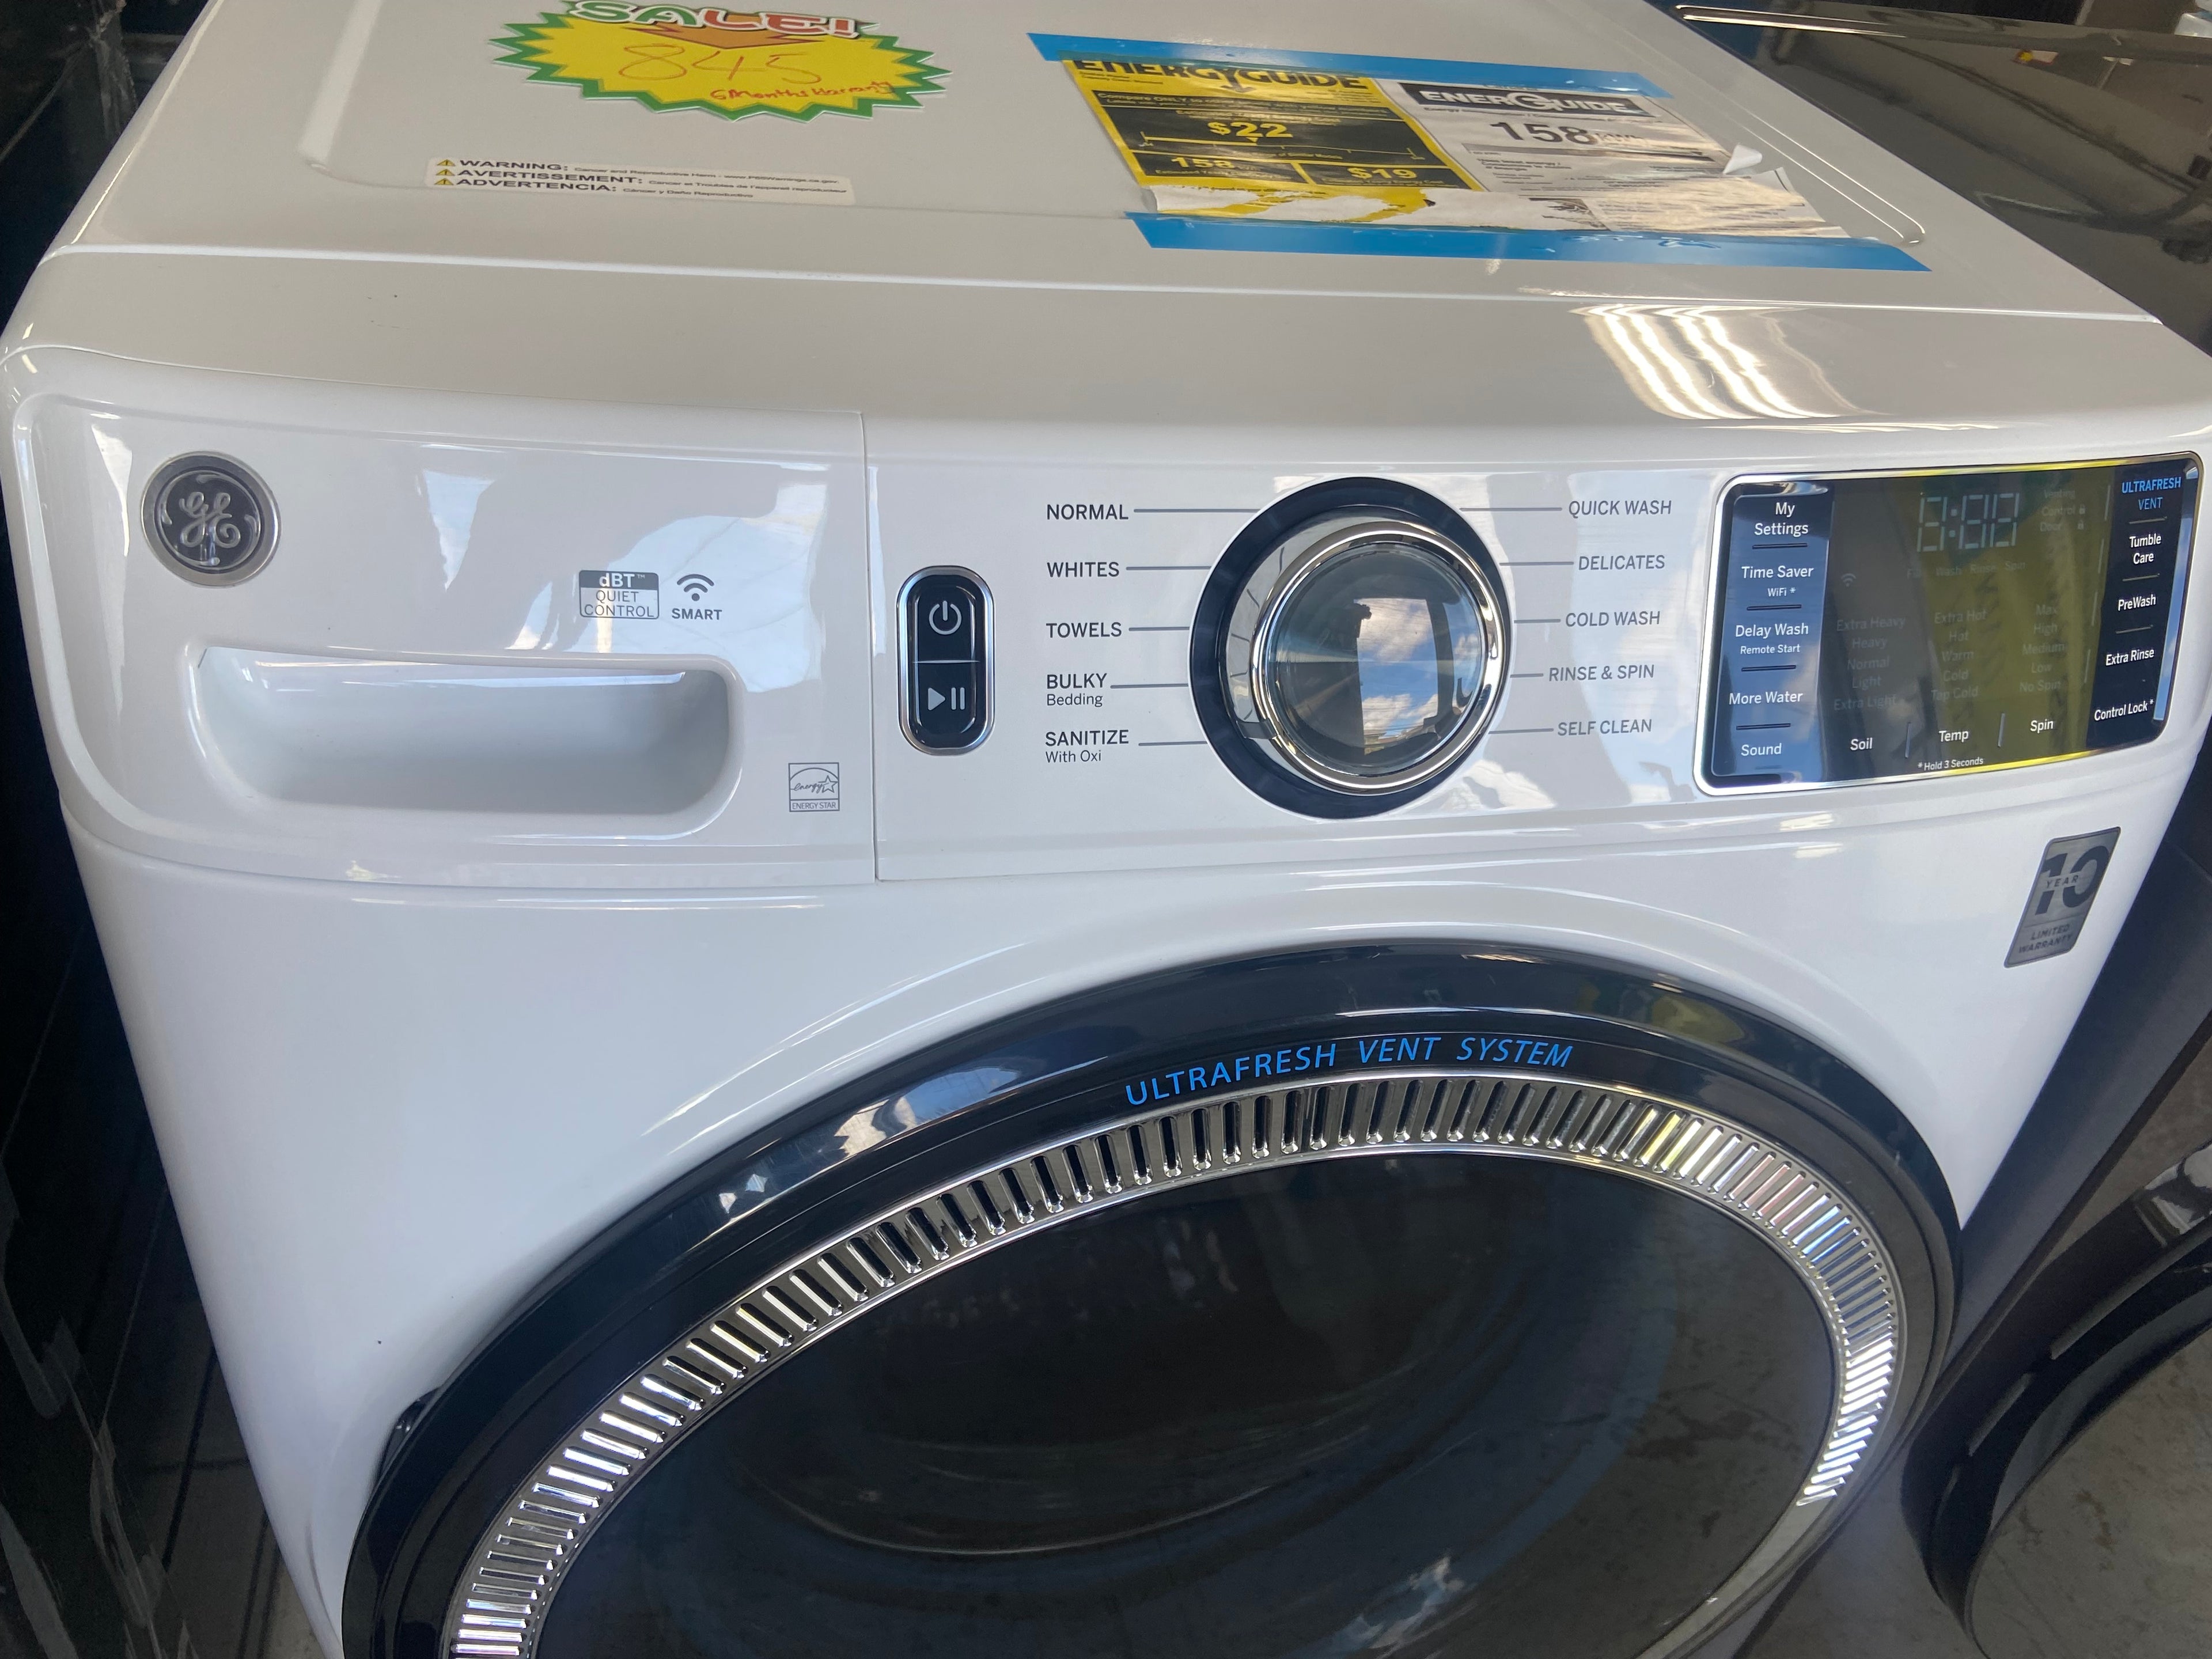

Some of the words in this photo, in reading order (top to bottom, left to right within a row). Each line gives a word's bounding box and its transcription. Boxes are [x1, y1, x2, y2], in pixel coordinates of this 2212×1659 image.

[570, 1, 859, 38] SALE!
[619, 43, 821, 85] 845
[1207, 122, 1294, 138] $22
[1490, 122, 1598, 145] 158
[459, 159, 568, 172] WARNING:
[1171, 157, 1235, 169] 158
[457, 169, 642, 184] AVERTISSEMENT:
[1347, 167, 1418, 179] $19
[456, 179, 617, 192] ADVERTENCIA:
[2122, 476, 2181, 494] ULTRAFRESH
[1046, 503, 1129, 520] NORMAL
[1569, 500, 1620, 518] QUICK
[1624, 499, 1672, 515] WASH
[1775, 502, 1796, 518] My
[2138, 497, 2164, 511] VENT
[1754, 522, 1809, 537] Settings
[2129, 533, 2162, 548] Tumble
[1578, 555, 1665, 570] DELICATES
[2133, 552, 2154, 565] Care
[1046, 561, 1120, 578] WHITES
[1741, 566, 1774, 579] Time
[1777, 565, 1814, 578] Saver
[596, 589, 639, 604] QUIET
[1767, 588, 1787, 597] WiFi
[2118, 593, 2157, 612] PreWash
[584, 604, 655, 618] CONTROL
[671, 607, 723, 620] SMART
[1565, 612, 1609, 627] COLD
[1613, 611, 1660, 626] WASH
[1046, 622, 1122, 638] TOWELS
[1735, 624, 1771, 639] Delay
[1774, 622, 1809, 636] Wash
[1740, 645, 1775, 654] Remote
[1778, 643, 1801, 653] Start
[2105, 653, 2129, 666] Extra
[2131, 649, 2155, 662] Rinse
[1549, 666, 1597, 681] RINSE
[1600, 666, 1612, 680] &
[1616, 664, 1654, 679] SPIN
[1046, 672, 1107, 690] BULKY
[1046, 694, 1103, 707] Bedding
[1729, 692, 1762, 705] More
[1765, 691, 1803, 703] Water
[2094, 704, 2126, 721] Control
[2128, 700, 2148, 714] Lock
[1557, 721, 1597, 736] SELF
[1600, 719, 1652, 734] CLEAN
[2029, 719, 2054, 734] Spin
[1044, 729, 1129, 747] SANITIZE
[1938, 729, 1969, 743] Temp
[1740, 743, 1782, 757] Sound
[1850, 737, 1873, 751] Soil
[1046, 750, 1077, 763] With
[1080, 749, 1102, 762] Oxi
[1944, 760, 1950, 769] 3
[1950, 757, 1984, 768] Seconds
[792, 802, 819, 810] ENERGY
[2035, 845, 2110, 916] 10
[2046, 874, 2080, 889] YEAR
[2031, 923, 2071, 941] LIMITED
[2018, 934, 2073, 954] WARRANTY
[1125, 1043, 1336, 1105] ULTRAFRESH
[1358, 1037, 1442, 1065] VENT
[1456, 1037, 1574, 1069] SYSTEM
